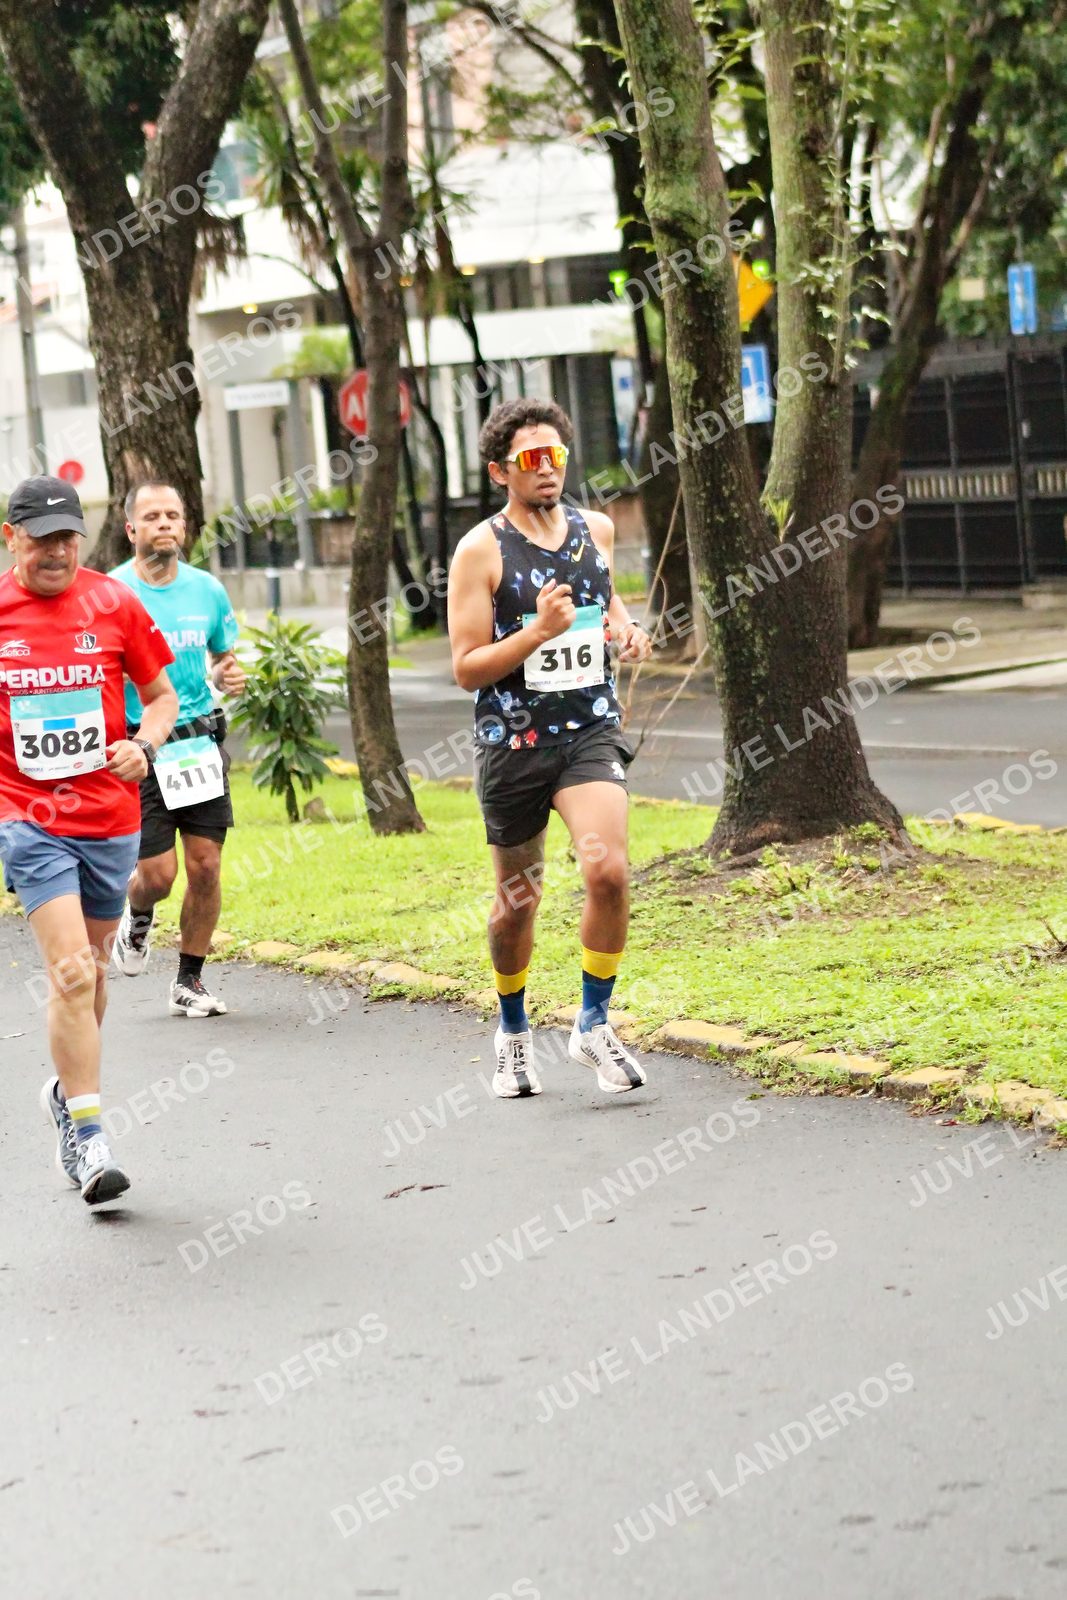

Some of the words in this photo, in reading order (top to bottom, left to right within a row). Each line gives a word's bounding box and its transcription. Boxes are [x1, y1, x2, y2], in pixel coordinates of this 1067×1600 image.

[540, 644, 592, 672] 316
[20, 727, 100, 759] 3082
[167, 763, 221, 791] 4111
